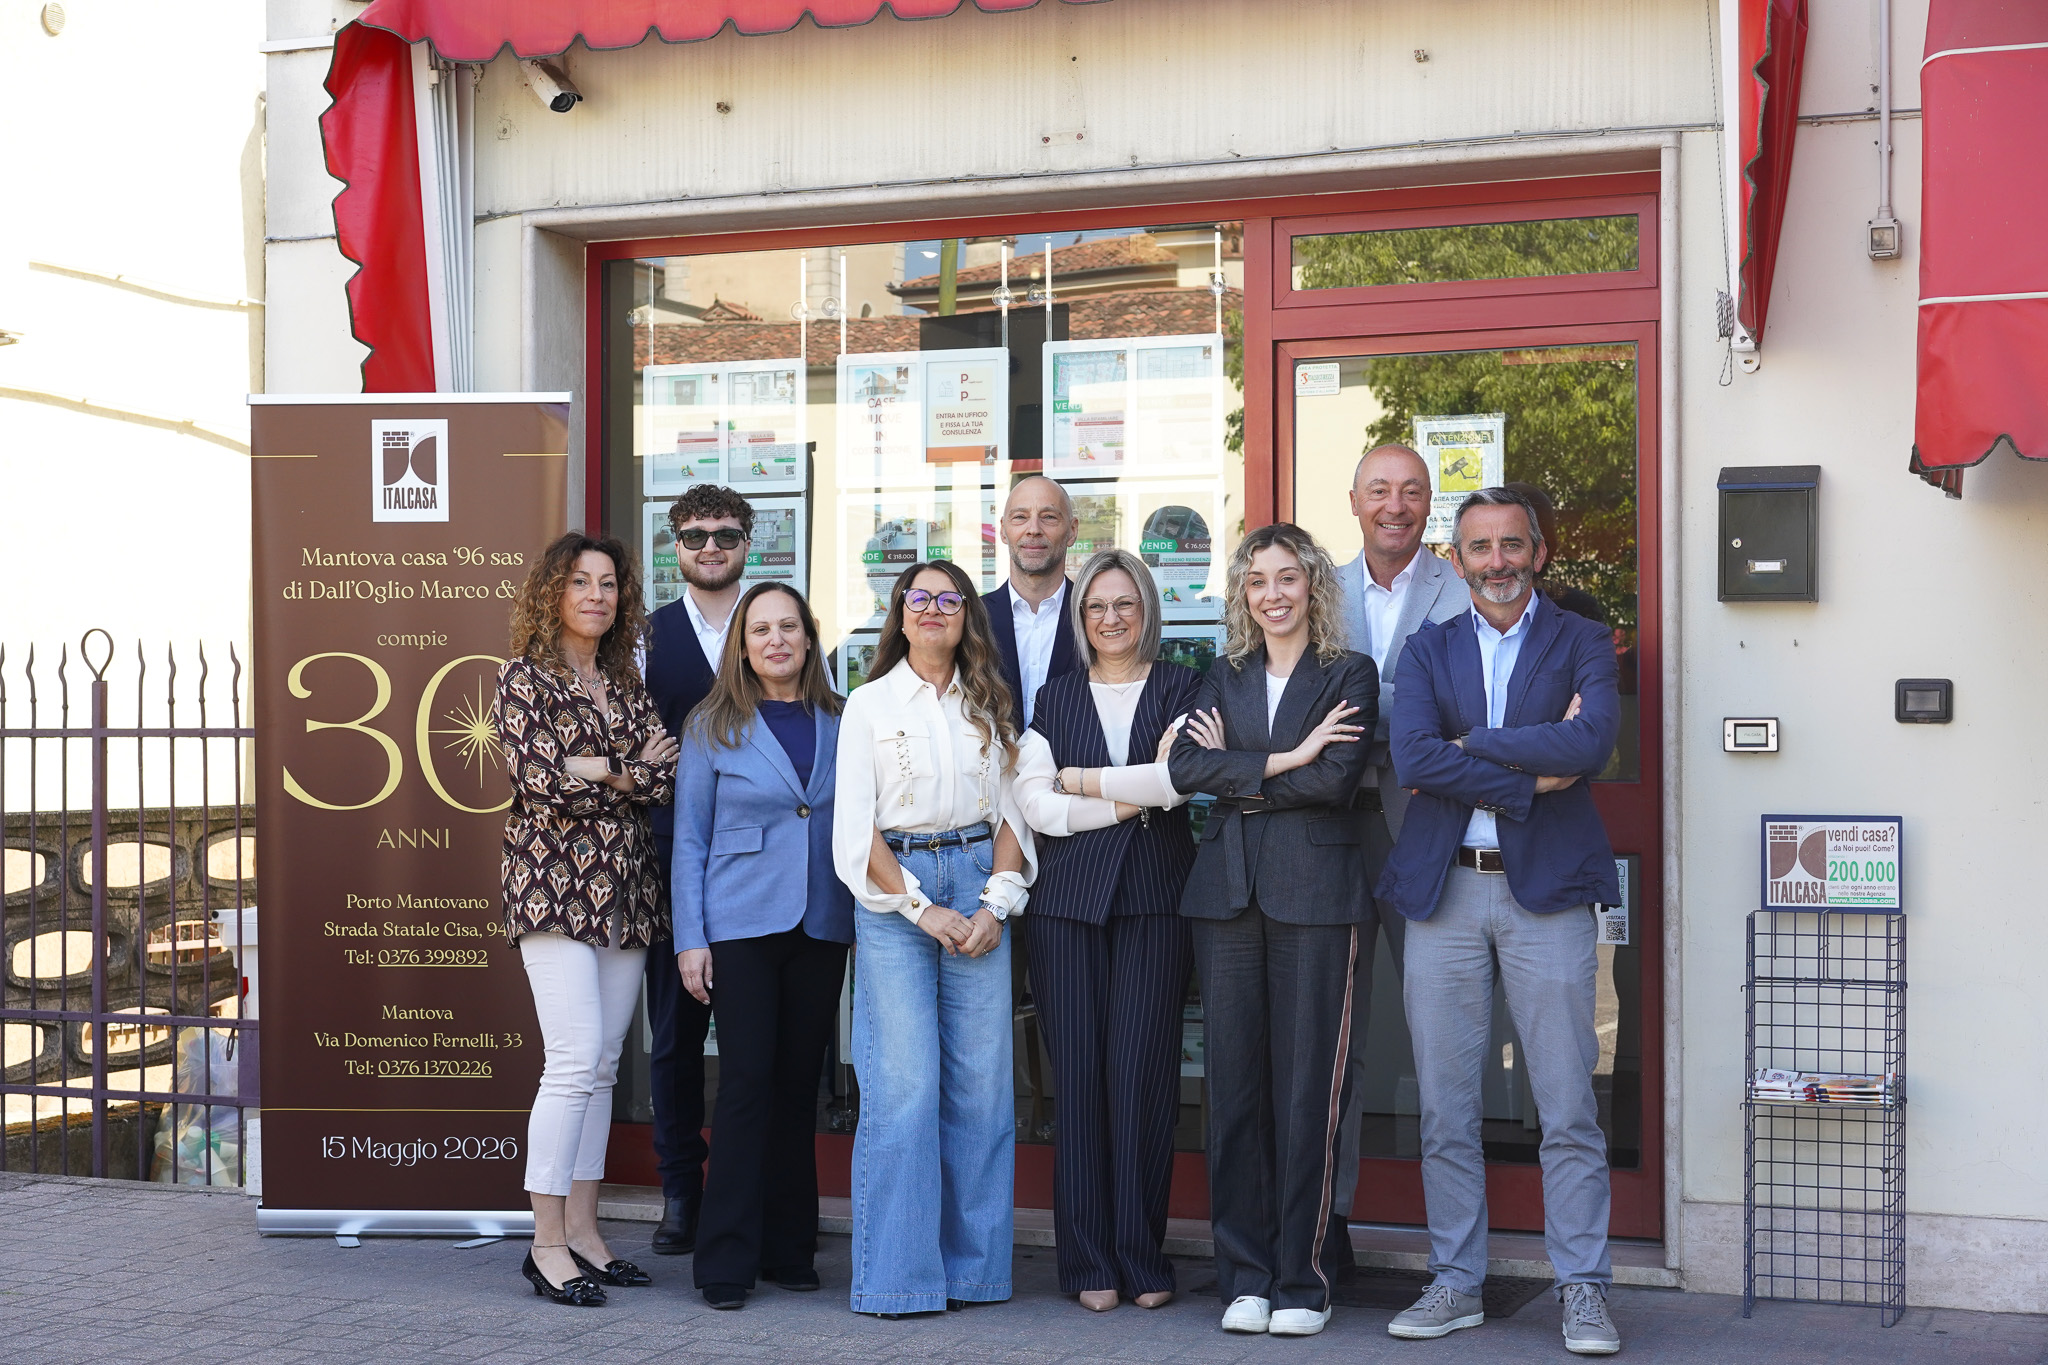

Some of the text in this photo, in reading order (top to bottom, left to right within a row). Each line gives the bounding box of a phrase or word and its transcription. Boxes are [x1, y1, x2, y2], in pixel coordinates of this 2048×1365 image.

[867, 397, 896, 408] CASE
[1056, 402, 1082, 410] VEND
[942, 428, 982, 436] CONSULENZA
[383, 486, 438, 510] ITALCASA
[929, 548, 952, 556] VEND
[1141, 542, 1173, 550] VENDE
[301, 547, 397, 567] Mantova
[401, 552, 449, 566] casa
[490, 552, 524, 566] sas
[655, 556, 678, 564] VEND
[282, 580, 303, 600] di
[419, 579, 490, 599] Marco
[495, 579, 516, 599] &
[376, 630, 448, 650] compie
[282, 651, 513, 814] 30
[376, 828, 450, 849] ANNI
[1827, 825, 1896, 842] vendi casa?
[1842, 844, 1854, 852] Noi
[1855, 844, 1871, 853] puoi!
[1872, 844, 1895, 852] Come?
[1828, 860, 1896, 882] 200.000
[1769, 880, 1828, 904] ITALCASA
[346, 893, 490, 910] Porto Mantovano
[324, 921, 379, 937] Strada
[382, 921, 440, 937] Statale
[445, 921, 483, 939] Cisa,
[344, 949, 488, 965] Tel: 0376 399892
[381, 1004, 454, 1020] Mantova
[313, 1031, 523, 1050] Via Domenico Fernelli, 33
[344, 1059, 493, 1076] Tel: 0376 1370226
[321, 1135, 518, 1167] 15 Maggio 2026
